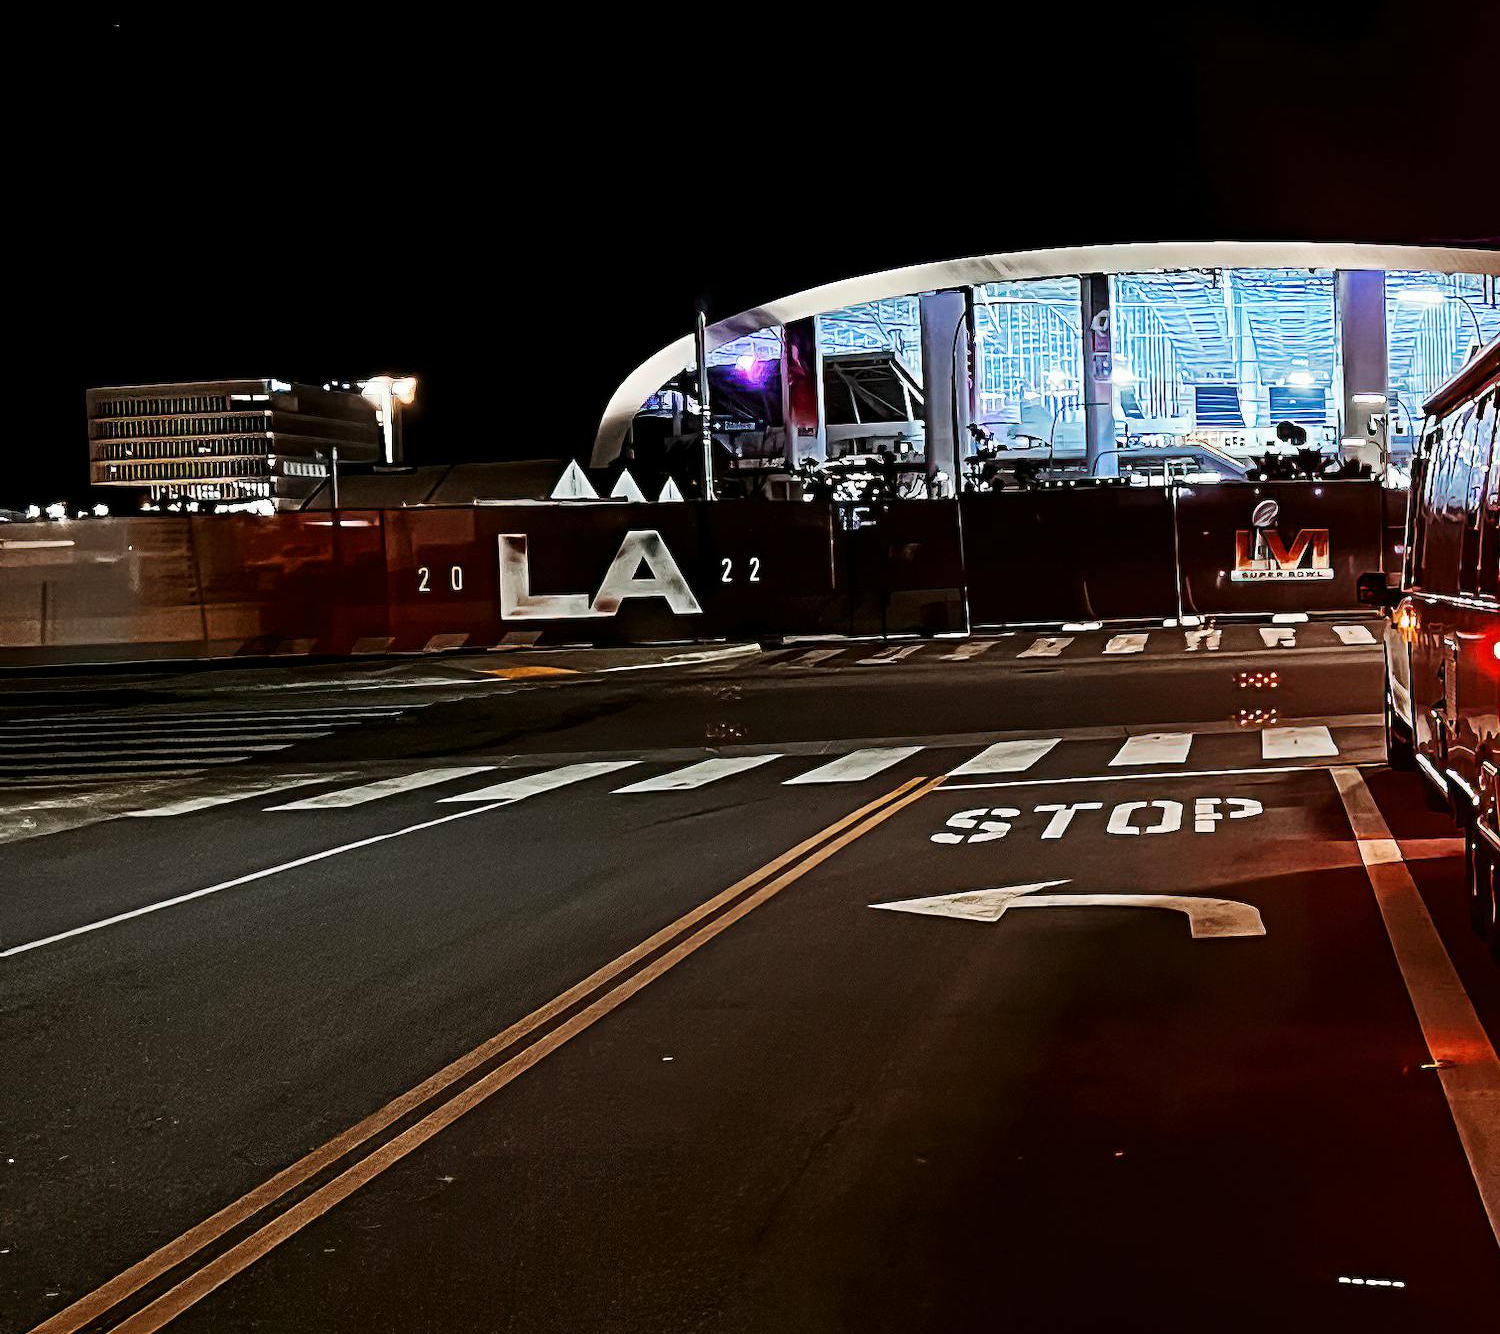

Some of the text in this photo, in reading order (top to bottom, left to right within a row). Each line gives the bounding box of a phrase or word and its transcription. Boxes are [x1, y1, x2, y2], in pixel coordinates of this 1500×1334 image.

[1235, 528, 1330, 571] LVI
[498, 530, 703, 619] LA
[1241, 571, 1324, 579] SUPER BOWL
[930, 797, 1264, 845] STOP
